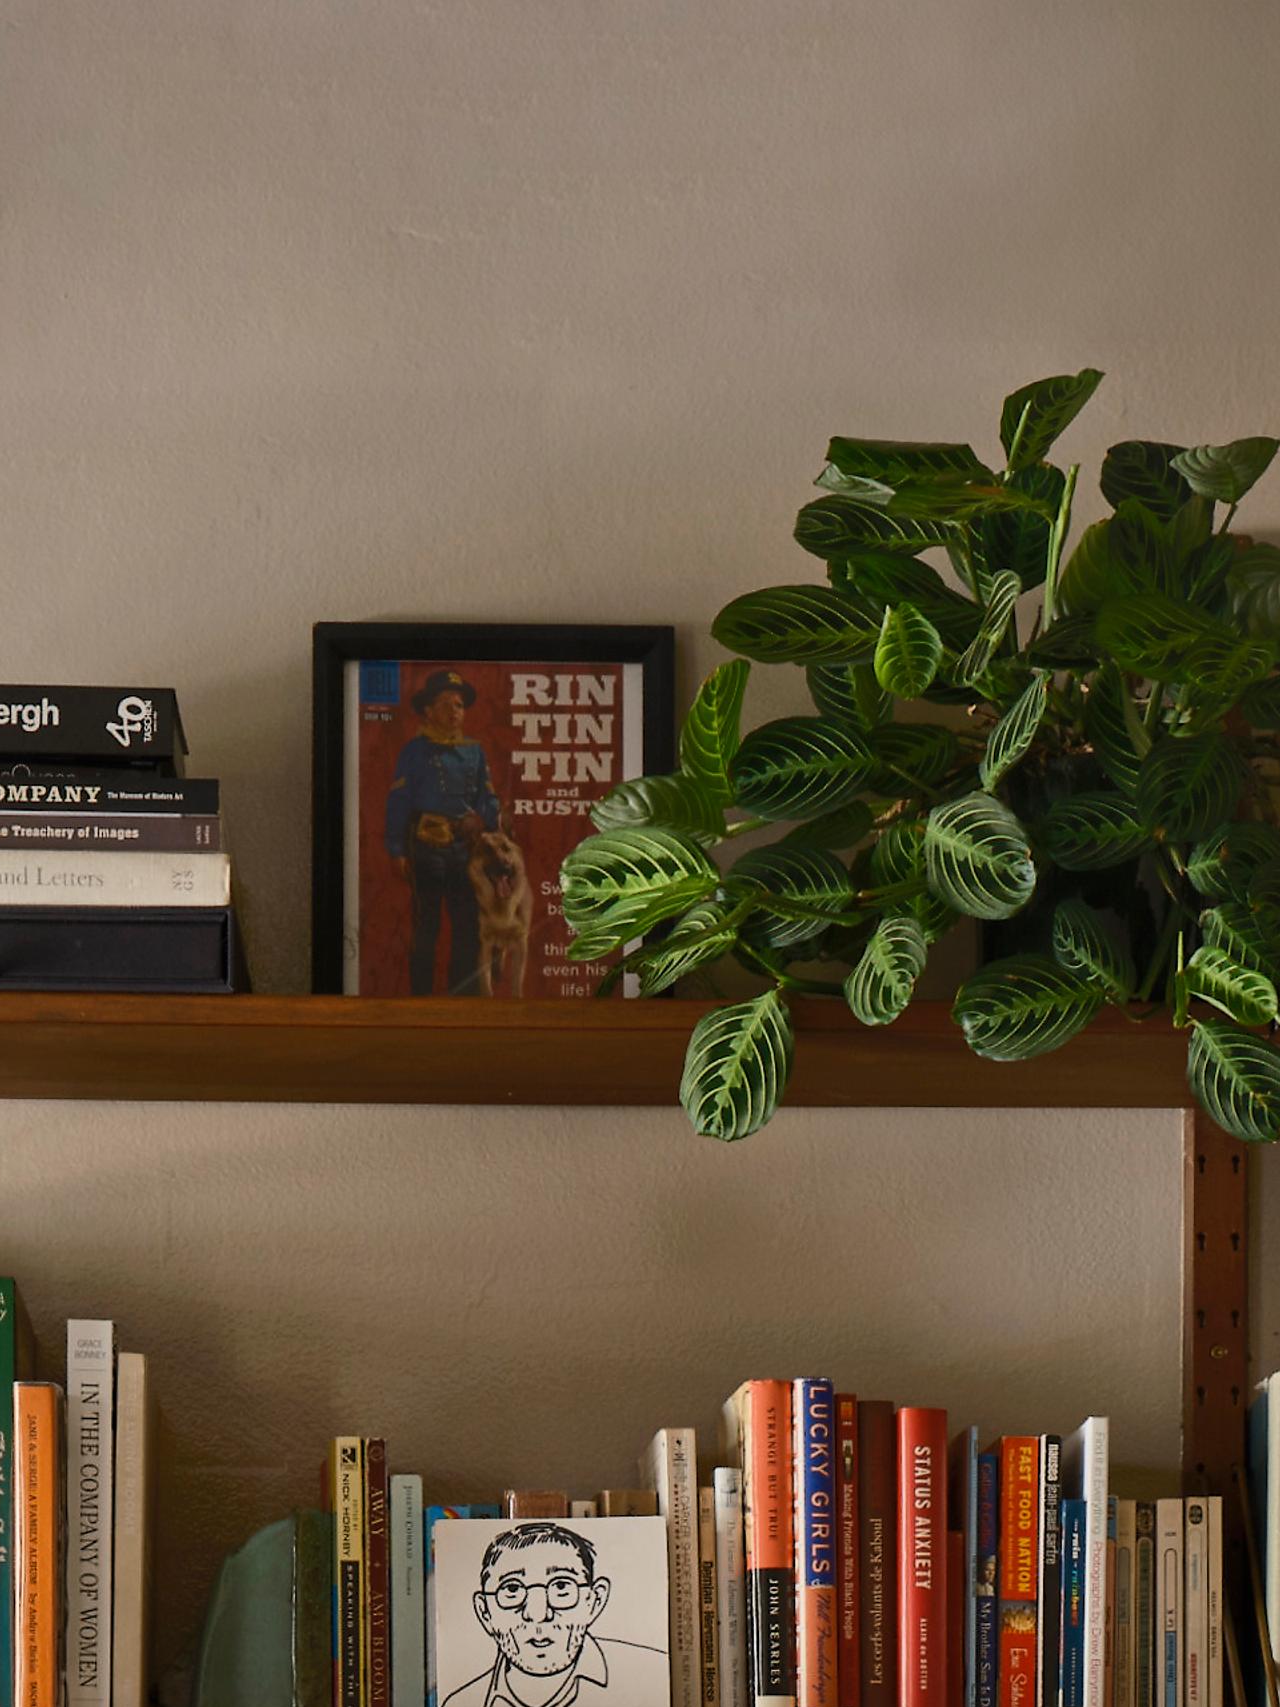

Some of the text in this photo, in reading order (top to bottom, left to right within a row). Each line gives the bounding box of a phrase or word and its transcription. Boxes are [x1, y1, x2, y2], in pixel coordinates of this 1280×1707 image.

[510, 674, 617, 706] RIN
[511, 714, 614, 745] TIN
[511, 751, 614, 783] TIN
[12, 825, 74, 842] Treachery
[78, 826, 90, 839] of
[94, 826, 140, 842] Images
[543, 963, 608, 977] even his
[767, 1407, 779, 1542] STRANGE BUT TRUE
[809, 1385, 830, 1573] LUCKY GIRLS
[341, 1473, 352, 1557] NICK HORNBY
[914, 1446, 931, 1589] STATUS ANXIETY
[1018, 1446, 1032, 1593] FAST FOOD NATION
[78, 1382, 100, 1689] IN THE COMPANY OF WOMEN
[370, 1485, 385, 1700] AWAY AMY BLOOM
[978, 1602, 991, 1621] My
[768, 1578, 781, 1685] JOHN SEARLES
[979, 1623, 992, 1658] Brother
[980, 1662, 991, 1682] Sam
[980, 1685, 991, 1694] Is
